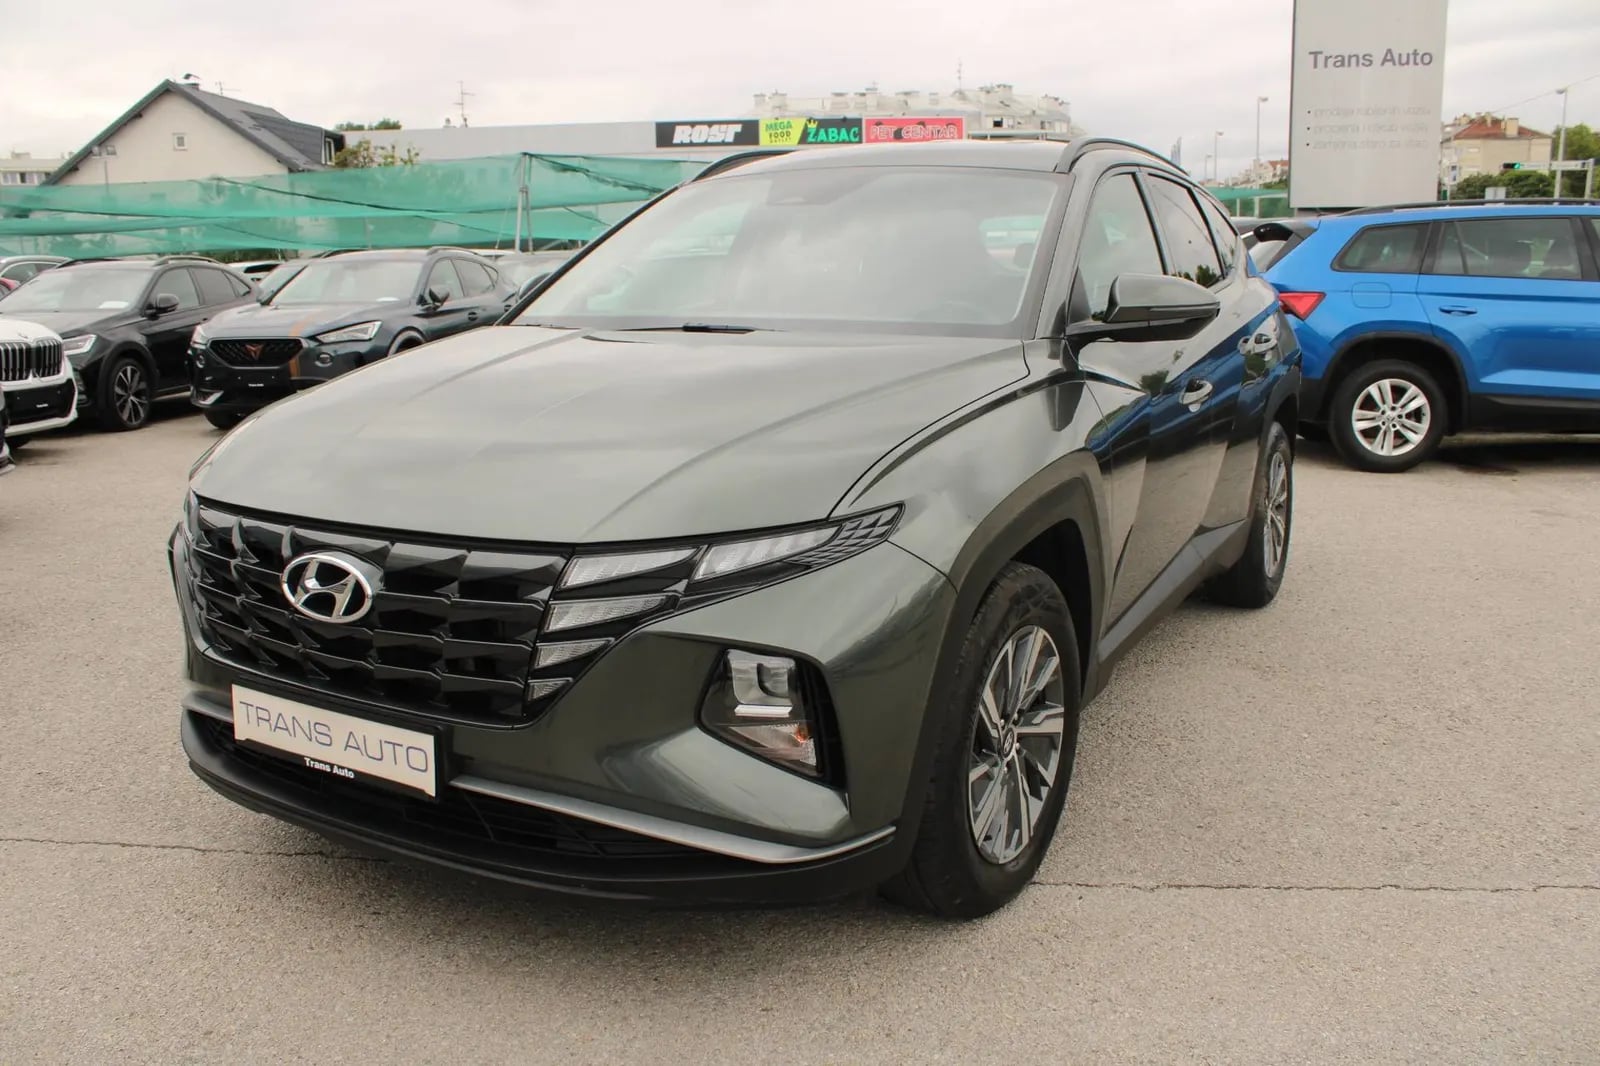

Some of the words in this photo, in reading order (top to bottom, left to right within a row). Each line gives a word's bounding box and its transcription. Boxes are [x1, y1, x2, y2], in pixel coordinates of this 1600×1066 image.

[1308, 51, 1373, 69] Trans
[1380, 48, 1433, 67] Auto
[672, 123, 743, 144] ROST
[765, 120, 793, 132] MEGA
[769, 130, 791, 139] FOOD
[871, 124, 895, 140] PET
[901, 124, 958, 139] CENTAR
[239, 701, 333, 748] TRANS
[343, 730, 429, 773] AUTO
[304, 757, 331, 773] Trans
[332, 763, 355, 779] Auto
